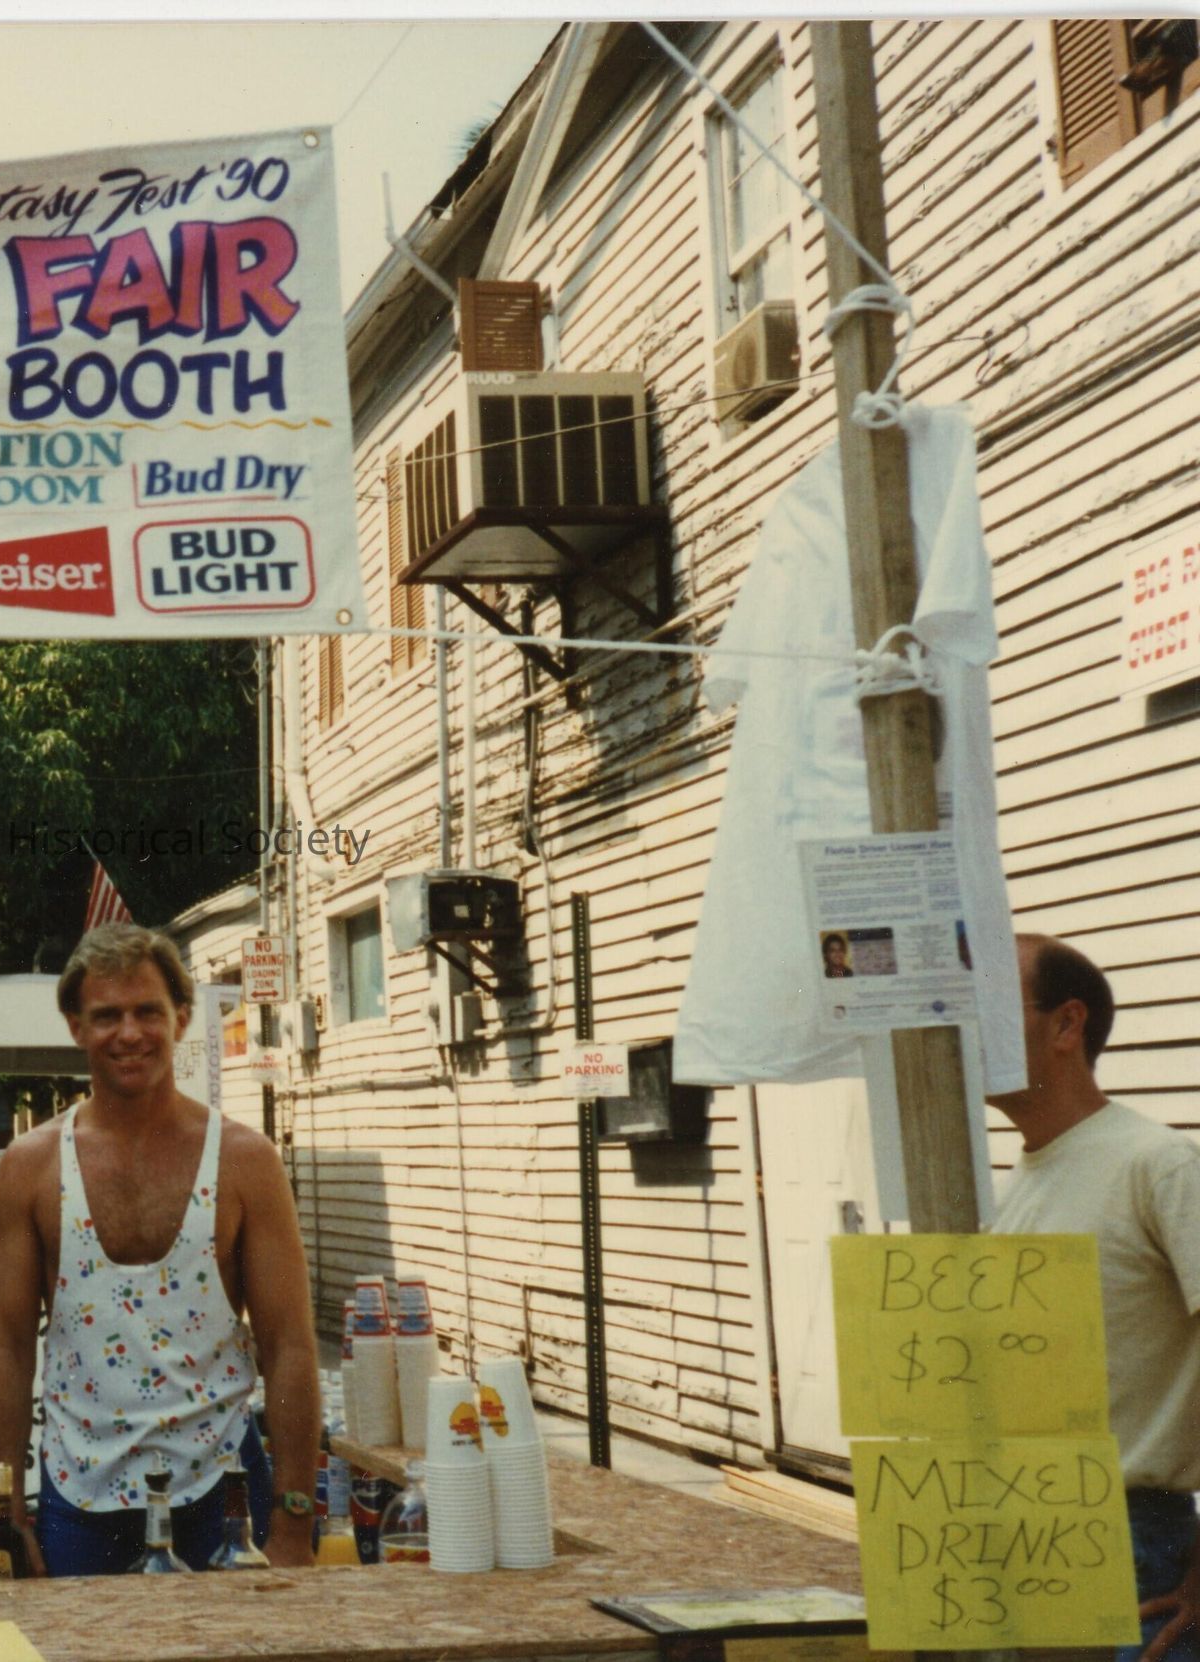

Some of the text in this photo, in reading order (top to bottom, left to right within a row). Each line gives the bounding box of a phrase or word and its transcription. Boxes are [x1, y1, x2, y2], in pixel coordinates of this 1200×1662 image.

[96, 167, 213, 235] Fest
[3, 216, 300, 345] FAIR
[6, 346, 287, 421] BOOTH
[144, 455, 304, 500] Bud Dry
[170, 527, 276, 561] BUD
[152, 561, 298, 596] LIGHT
[244, 954, 284, 967] PARKING
[254, 940, 272, 952] NO
[246, 968, 282, 979] LOADING
[253, 979, 275, 989] ZONE
[565, 1064, 624, 1075] PARKING
[584, 1053, 603, 1063] NO
[880, 1247, 1047, 1312] BEER
[871, 1453, 1112, 1514] MIXED
[897, 1516, 1108, 1574] DRINKS
